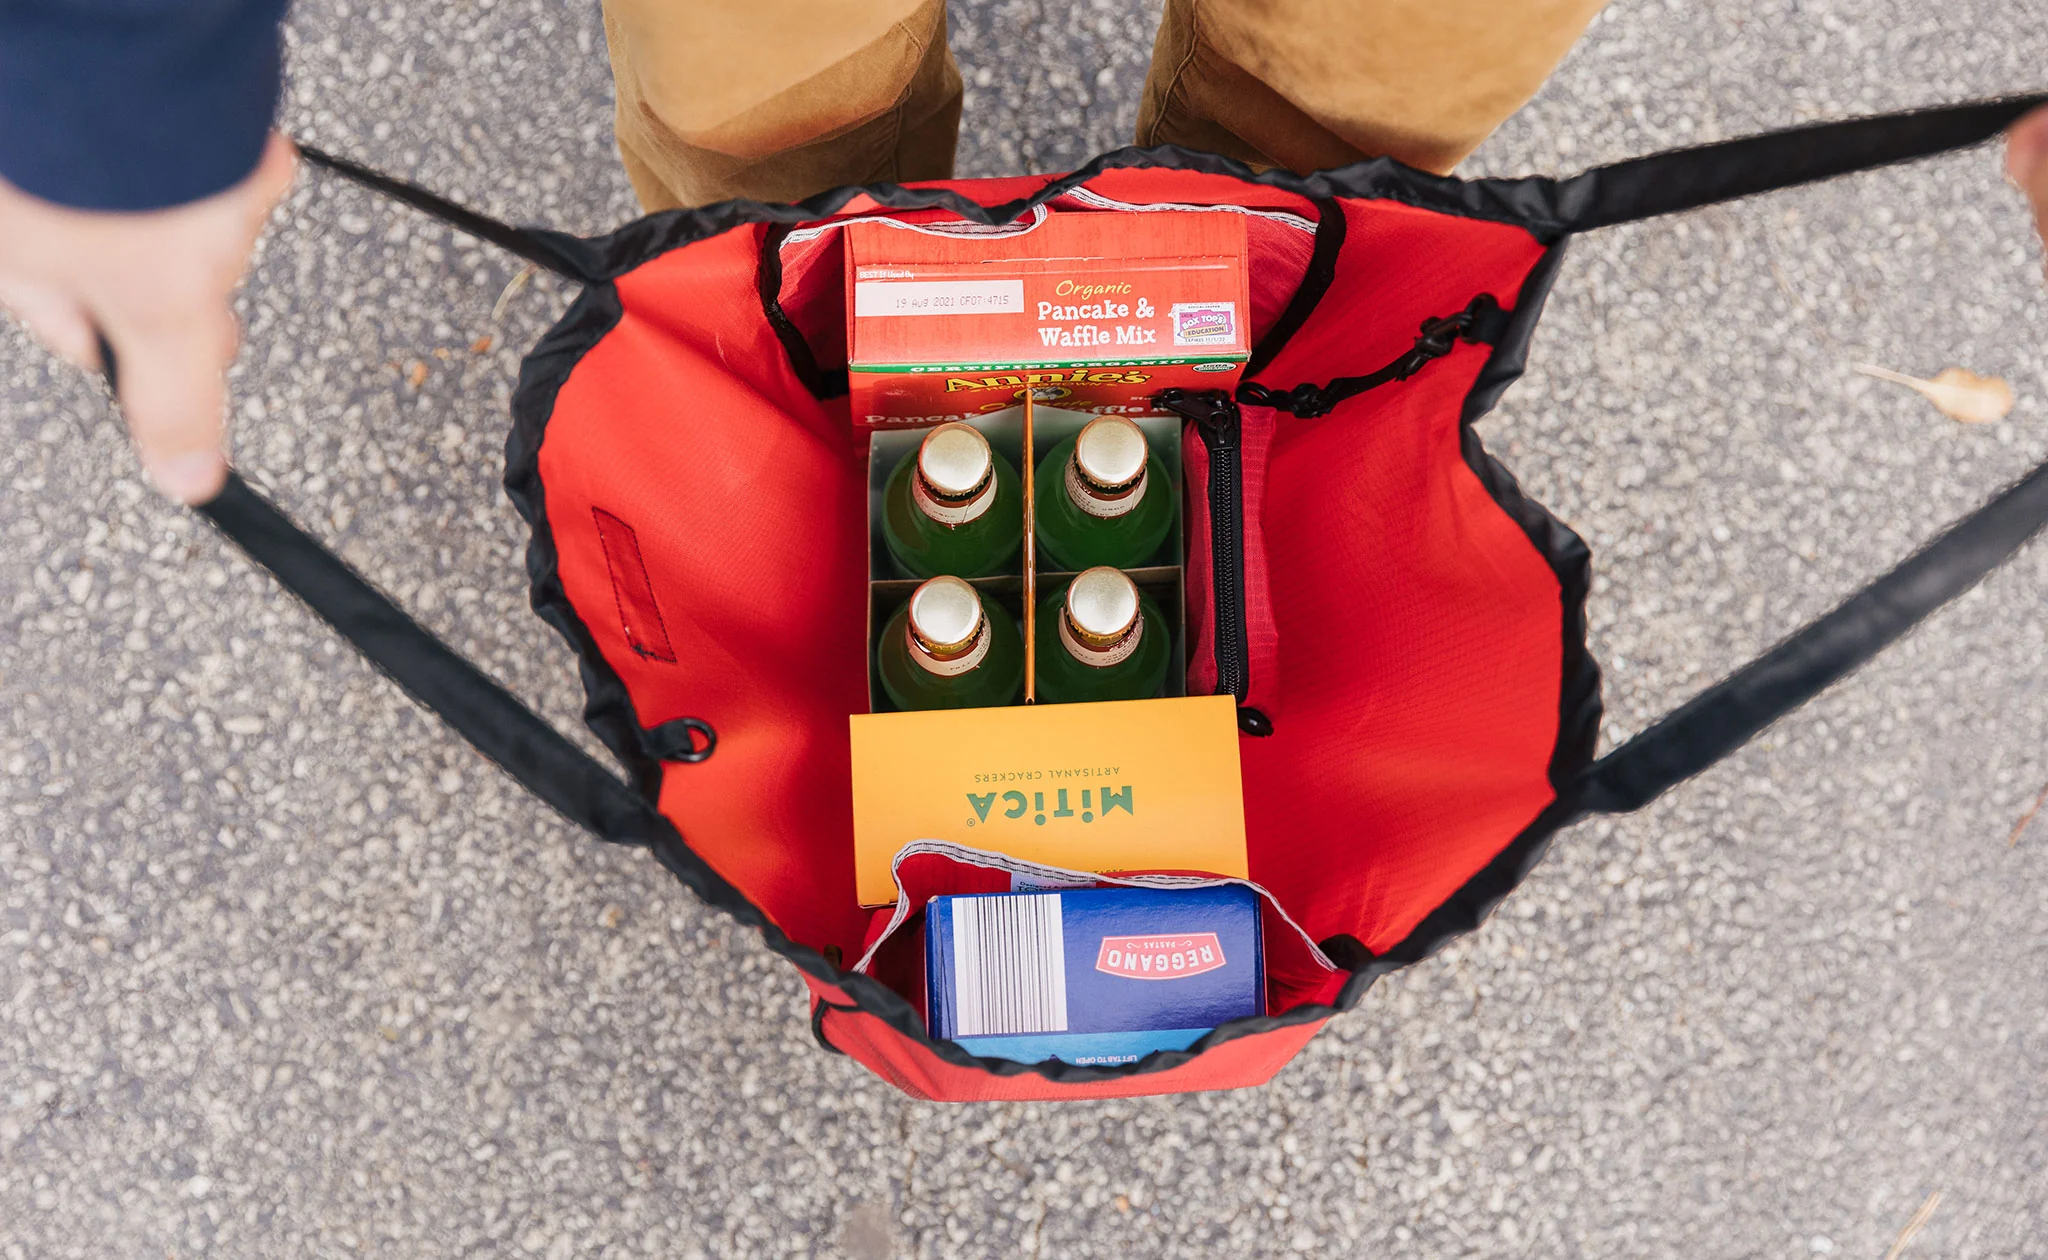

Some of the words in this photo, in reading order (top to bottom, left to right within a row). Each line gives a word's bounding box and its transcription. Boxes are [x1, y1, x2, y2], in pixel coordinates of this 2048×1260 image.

[860, 271, 878, 279] BEST
[888, 270, 904, 278] Used
[905, 270, 914, 280] By
[1055, 280, 1132, 300] Organic
[896, 298, 907, 308] 19
[934, 296, 955, 307] 2021
[1037, 299, 1130, 321] Pancake
[1135, 297, 1155, 318] &
[1181, 316, 1200, 330] BOX
[1037, 325, 1111, 347] Waffle
[1116, 325, 1156, 345] Mix
[1187, 326, 1225, 336] EDUCATION
[910, 363, 1060, 373] CERTIFIED
[1070, 359, 1186, 368] ORGANIC
[945, 368, 1153, 393] Annie's
[865, 412, 980, 424] Pancak
[974, 770, 1042, 783] CRACKERS
[1048, 767, 1120, 779] ARTISANAL
[1143, 940, 1176, 949] PASTAS
[1107, 944, 1215, 972] REGGANO
[1075, 1056, 1096, 1065] OPEN
[1107, 1055, 1121, 1063] TAB
[1122, 1054, 1138, 1062] LIFT
